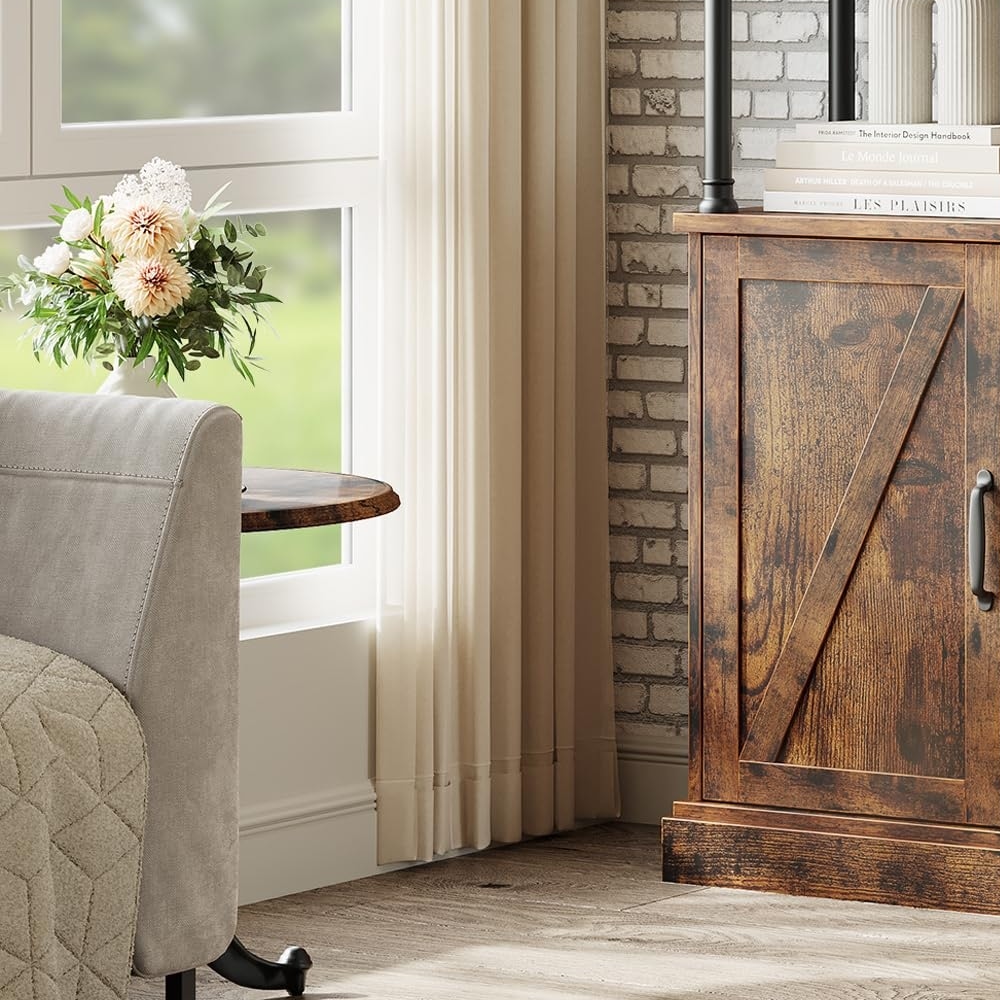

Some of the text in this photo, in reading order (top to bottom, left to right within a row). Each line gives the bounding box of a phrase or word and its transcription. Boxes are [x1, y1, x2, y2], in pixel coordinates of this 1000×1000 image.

[859, 130, 971, 141] The Interior Design Handbook
[856, 151, 896, 162] Monde
[853, 198, 966, 213] LES PLAISIRS
